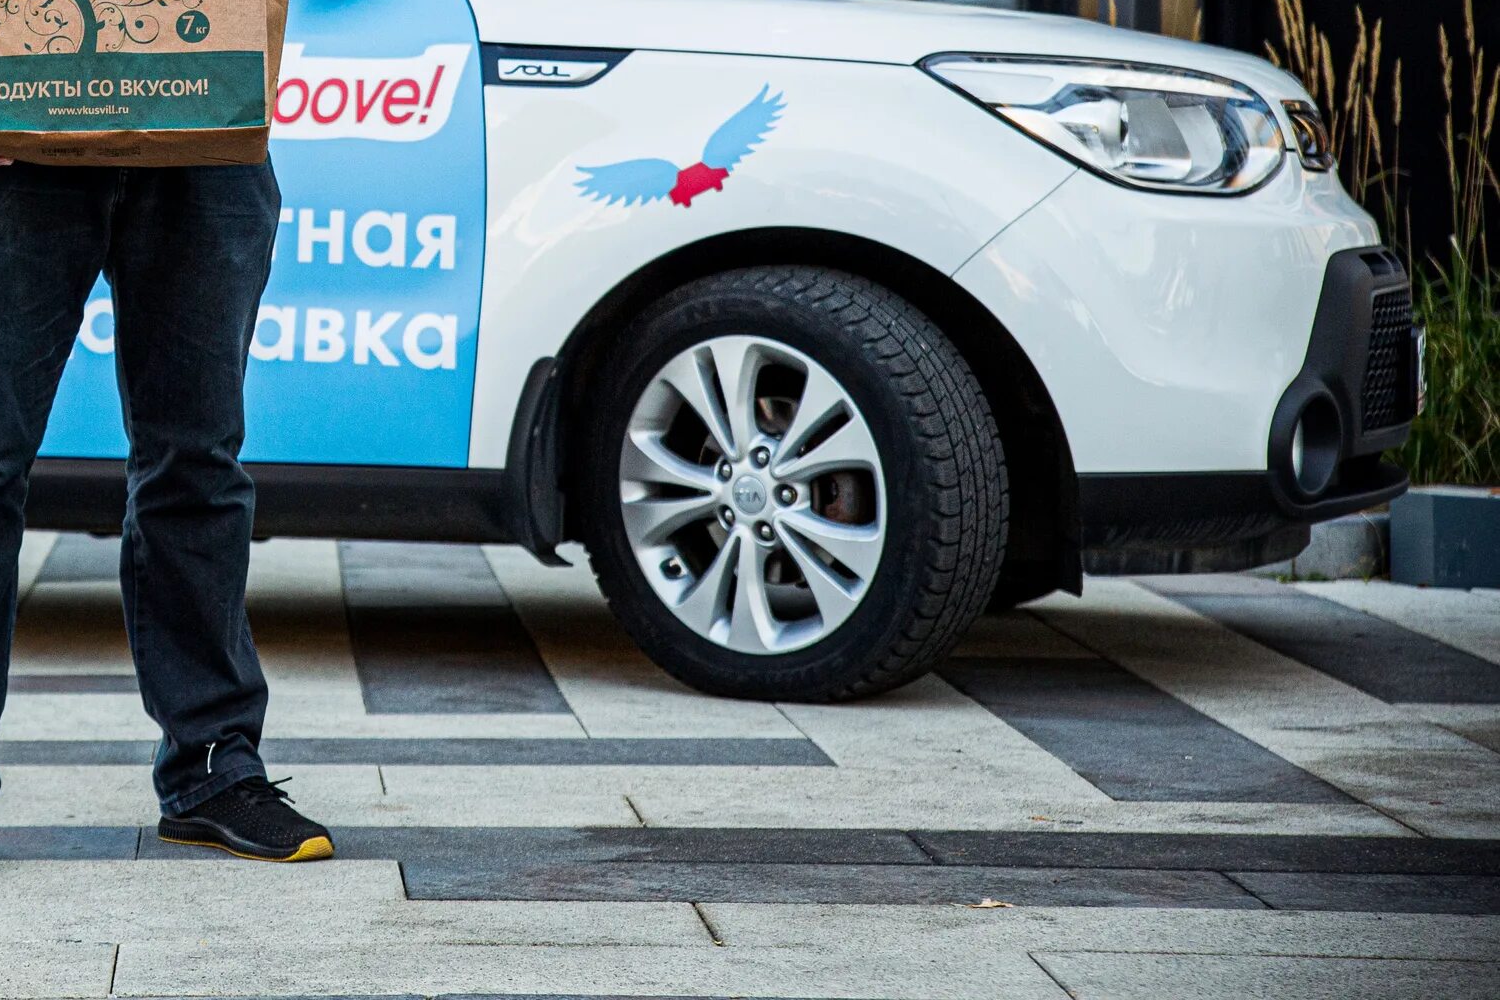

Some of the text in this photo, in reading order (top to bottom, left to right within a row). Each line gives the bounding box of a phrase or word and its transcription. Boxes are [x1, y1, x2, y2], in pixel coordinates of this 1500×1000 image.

[182, 15, 208, 35] 7 кг
[87, 79, 114, 97] СО
[120, 79, 209, 97] ВКУСОМ!
[273, 65, 445, 124] oove!
[48, 104, 129, 115] www.vkusvill.ru
